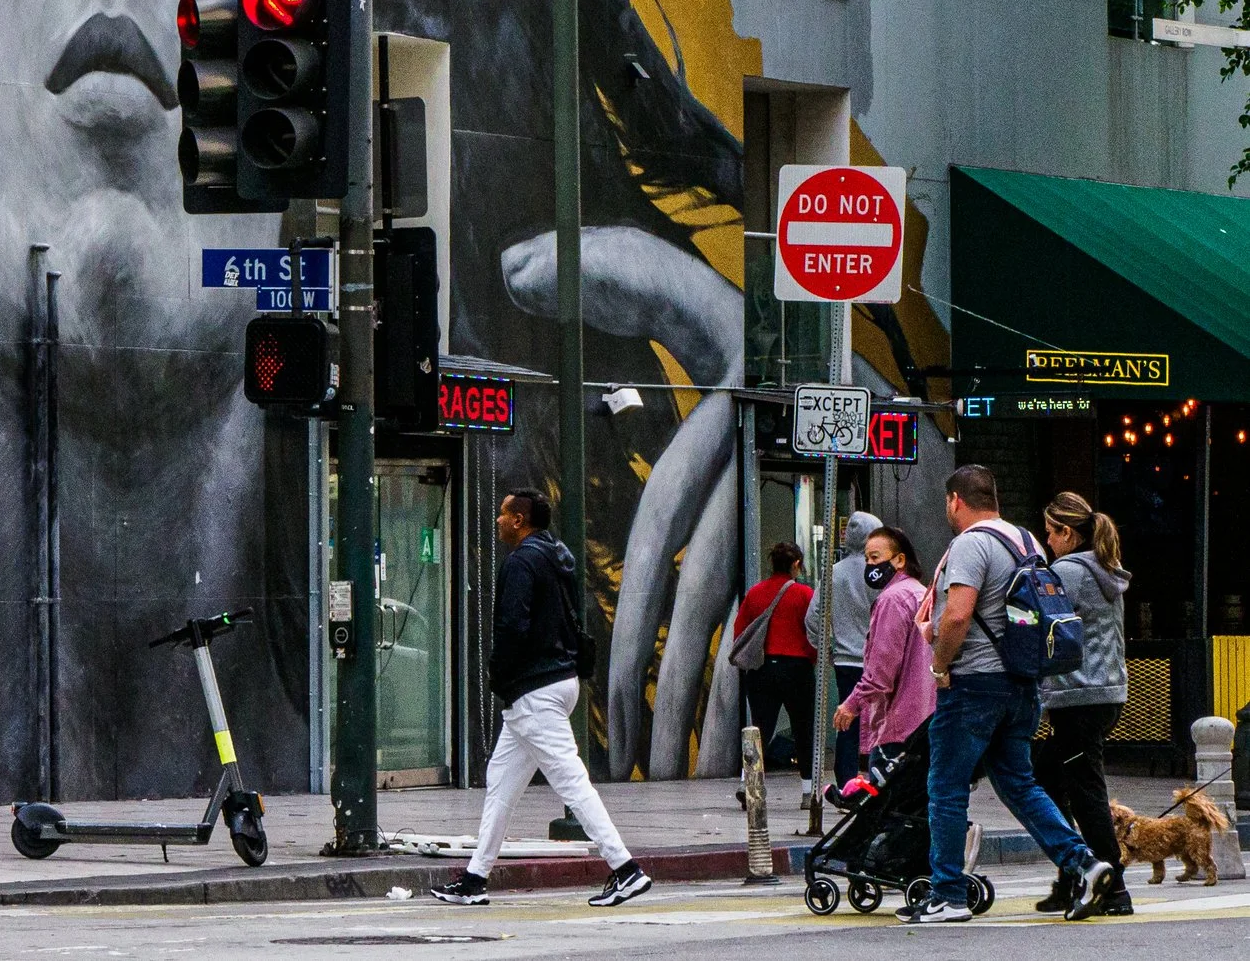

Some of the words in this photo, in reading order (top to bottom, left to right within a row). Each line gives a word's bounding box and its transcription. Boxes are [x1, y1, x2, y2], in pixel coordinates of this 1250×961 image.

[798, 194, 828, 215] DO
[839, 194, 884, 216] NOT
[224, 255, 266, 281] 6th
[278, 255, 306, 281] St
[804, 252, 873, 275] ENTER
[303, 291, 315, 308] W
[438, 384, 509, 423] RAGES
[963, 397, 995, 417] ET
[1017, 398, 1048, 410] we're
[1049, 397, 1073, 410] here
[421, 535, 431, 556] A
